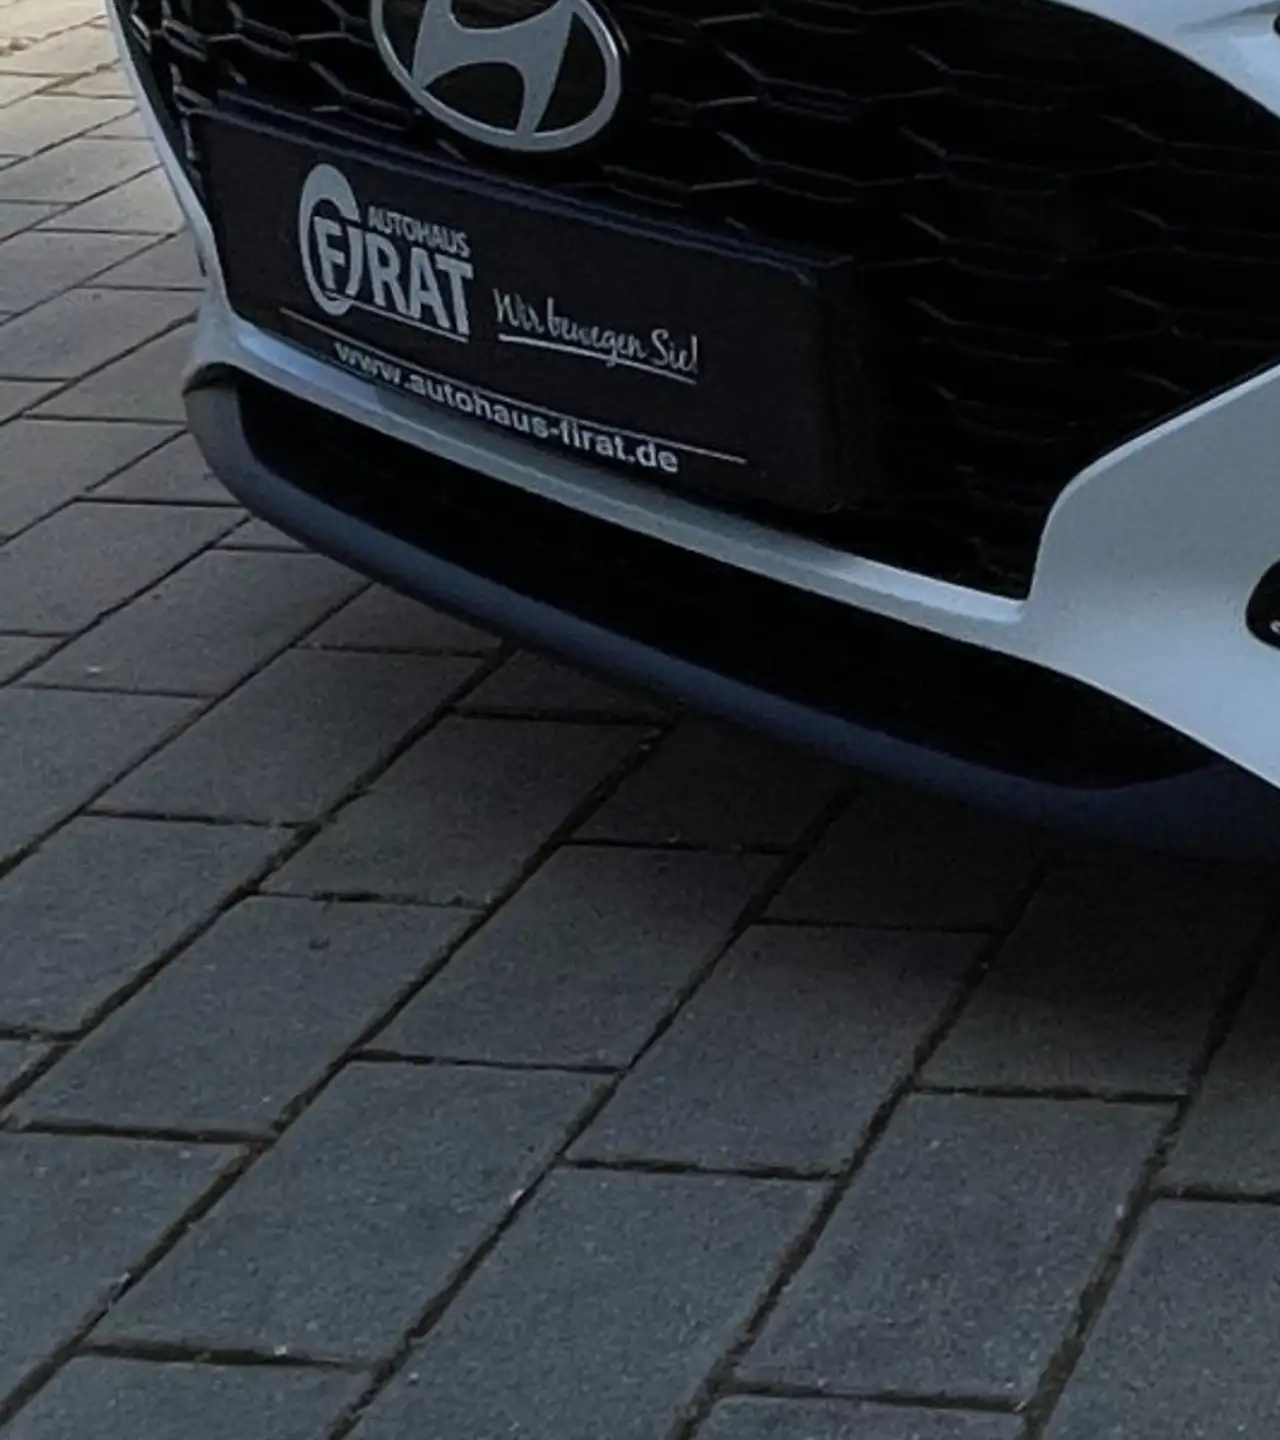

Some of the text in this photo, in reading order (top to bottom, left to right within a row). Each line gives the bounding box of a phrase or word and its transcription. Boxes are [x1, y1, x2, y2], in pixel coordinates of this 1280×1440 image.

[313, 215, 474, 336] FIRAT
[368, 204, 472, 257] AUTOHAUS
[492, 287, 543, 333] Wir
[546, 296, 648, 368] bewegen
[334, 340, 680, 474] www.autohaus-firat.de
